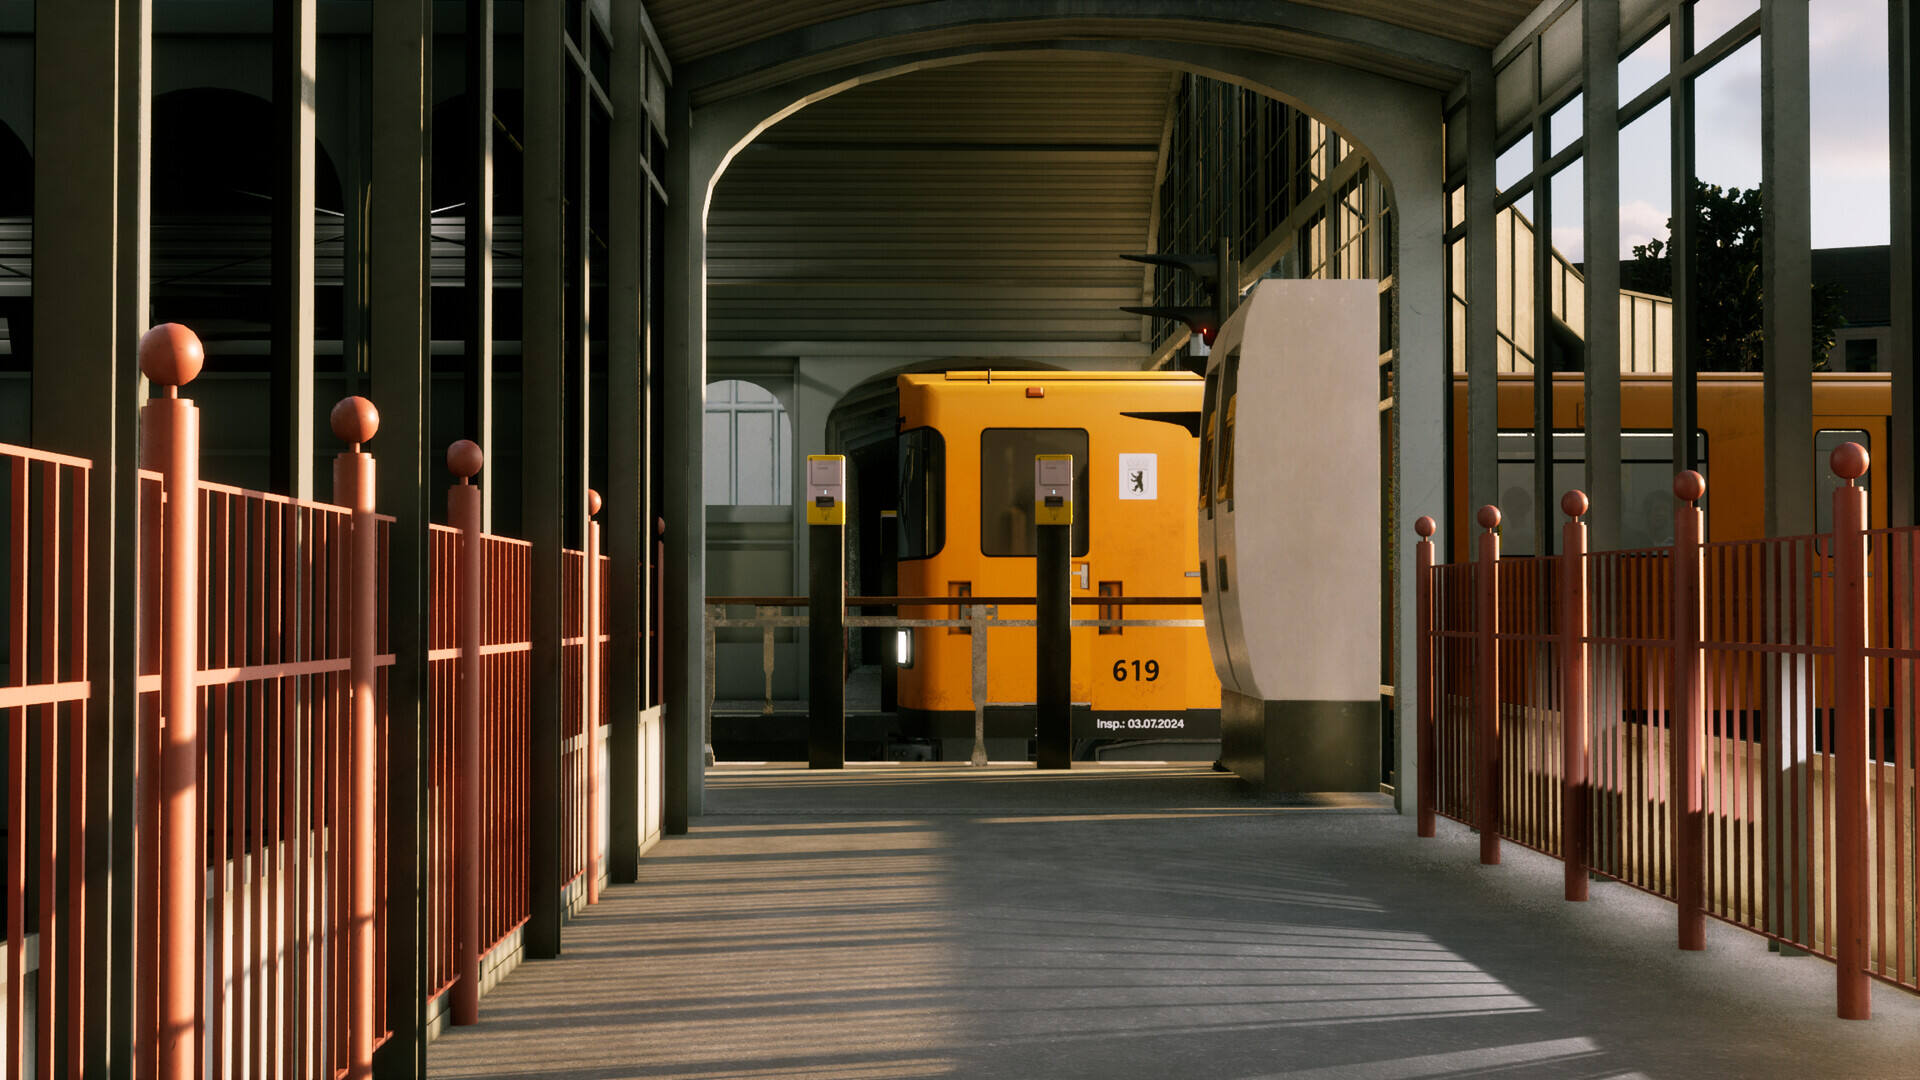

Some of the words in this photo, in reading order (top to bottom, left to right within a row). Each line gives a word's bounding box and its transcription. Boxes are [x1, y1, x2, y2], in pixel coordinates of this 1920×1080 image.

[1112, 659, 1160, 682] 619
[1096, 718, 1126, 731] Insp.:
[1127, 718, 1185, 729] 03.07.2024
